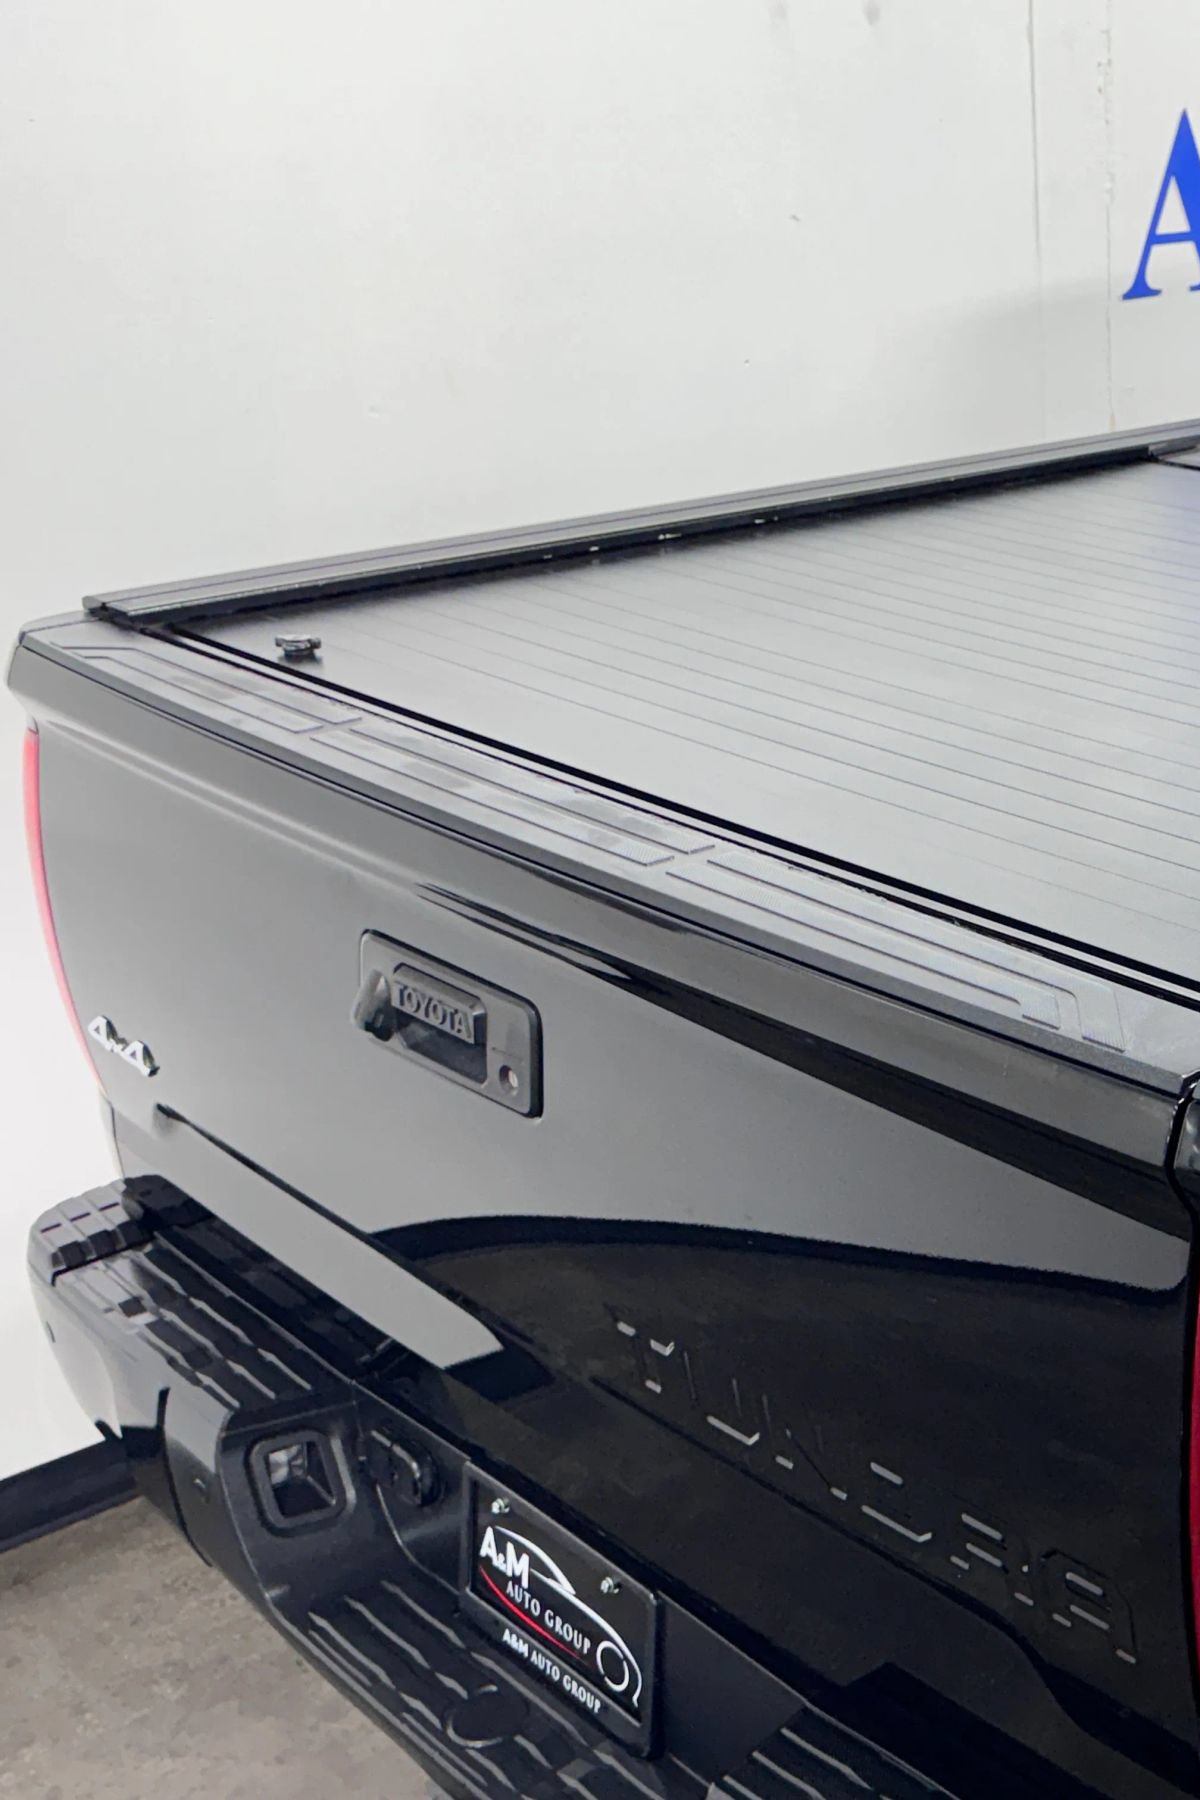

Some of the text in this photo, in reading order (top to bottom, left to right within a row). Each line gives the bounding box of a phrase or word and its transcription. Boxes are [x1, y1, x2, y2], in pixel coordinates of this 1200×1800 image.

[397, 983, 474, 1041] TOYOTA
[87, 1014, 161, 1078] 4x4
[479, 1526, 530, 1589] A&M
[505, 1580, 592, 1655] AUTO GROUP
[501, 1628, 601, 1714] A&M AUTO GROUP
